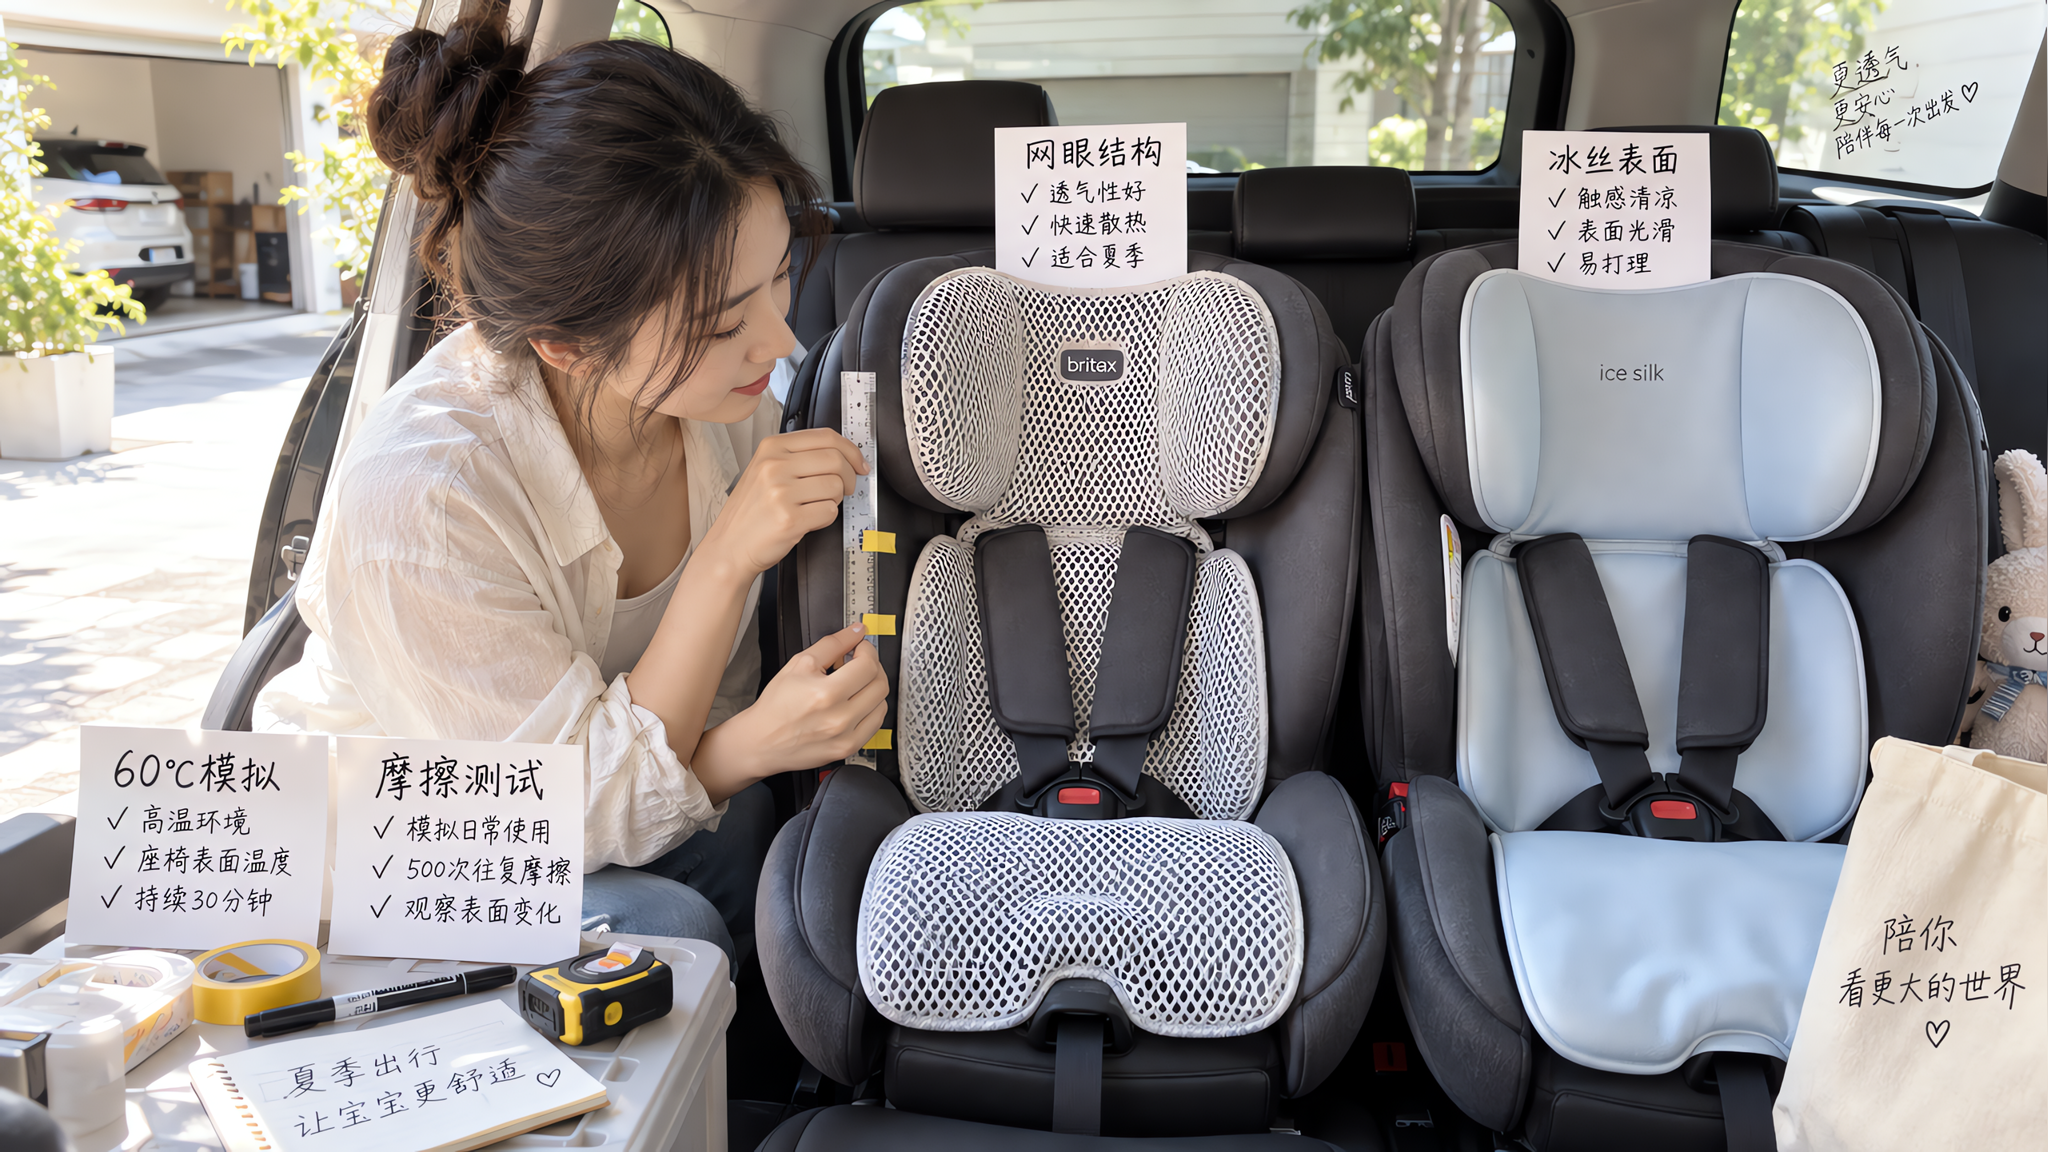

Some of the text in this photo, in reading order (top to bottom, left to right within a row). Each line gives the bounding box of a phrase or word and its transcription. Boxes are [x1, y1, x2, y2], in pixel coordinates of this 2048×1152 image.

[1830, 45, 1908, 100] 更透气
[1833, 89, 1896, 131] 更安心
[1835, 90, 1960, 160] 陪伴每一次出发
[1027, 136, 1161, 170] 网眼结构
[1549, 143, 1677, 175] 冰丝表面
[1050, 181, 1146, 204] 透气性好
[1578, 186, 1677, 210] 触感清凉
[1051, 211, 1146, 236] 快速散热
[1578, 218, 1675, 243] 表面光滑
[1051, 242, 1144, 269] 适合夏季
[1580, 252, 1651, 275] 易打理
[1067, 356, 1117, 374] britax
[1600, 364, 1663, 381] ice silk
[376, 752, 543, 801] 摩擦测试
[143, 804, 250, 835] 高温环境
[407, 814, 549, 846] 模拟日常使用
[138, 844, 291, 876] 座椅表面温度
[407, 855, 571, 886] 500次往复摩擦
[135, 885, 272, 917] 持续30分钟
[405, 893, 560, 926] 观察表面变化
[1883, 914, 1957, 955] 陪你
[1839, 963, 2025, 1010] 看更大的世界
[283, 1045, 440, 1099] 夏季出行
